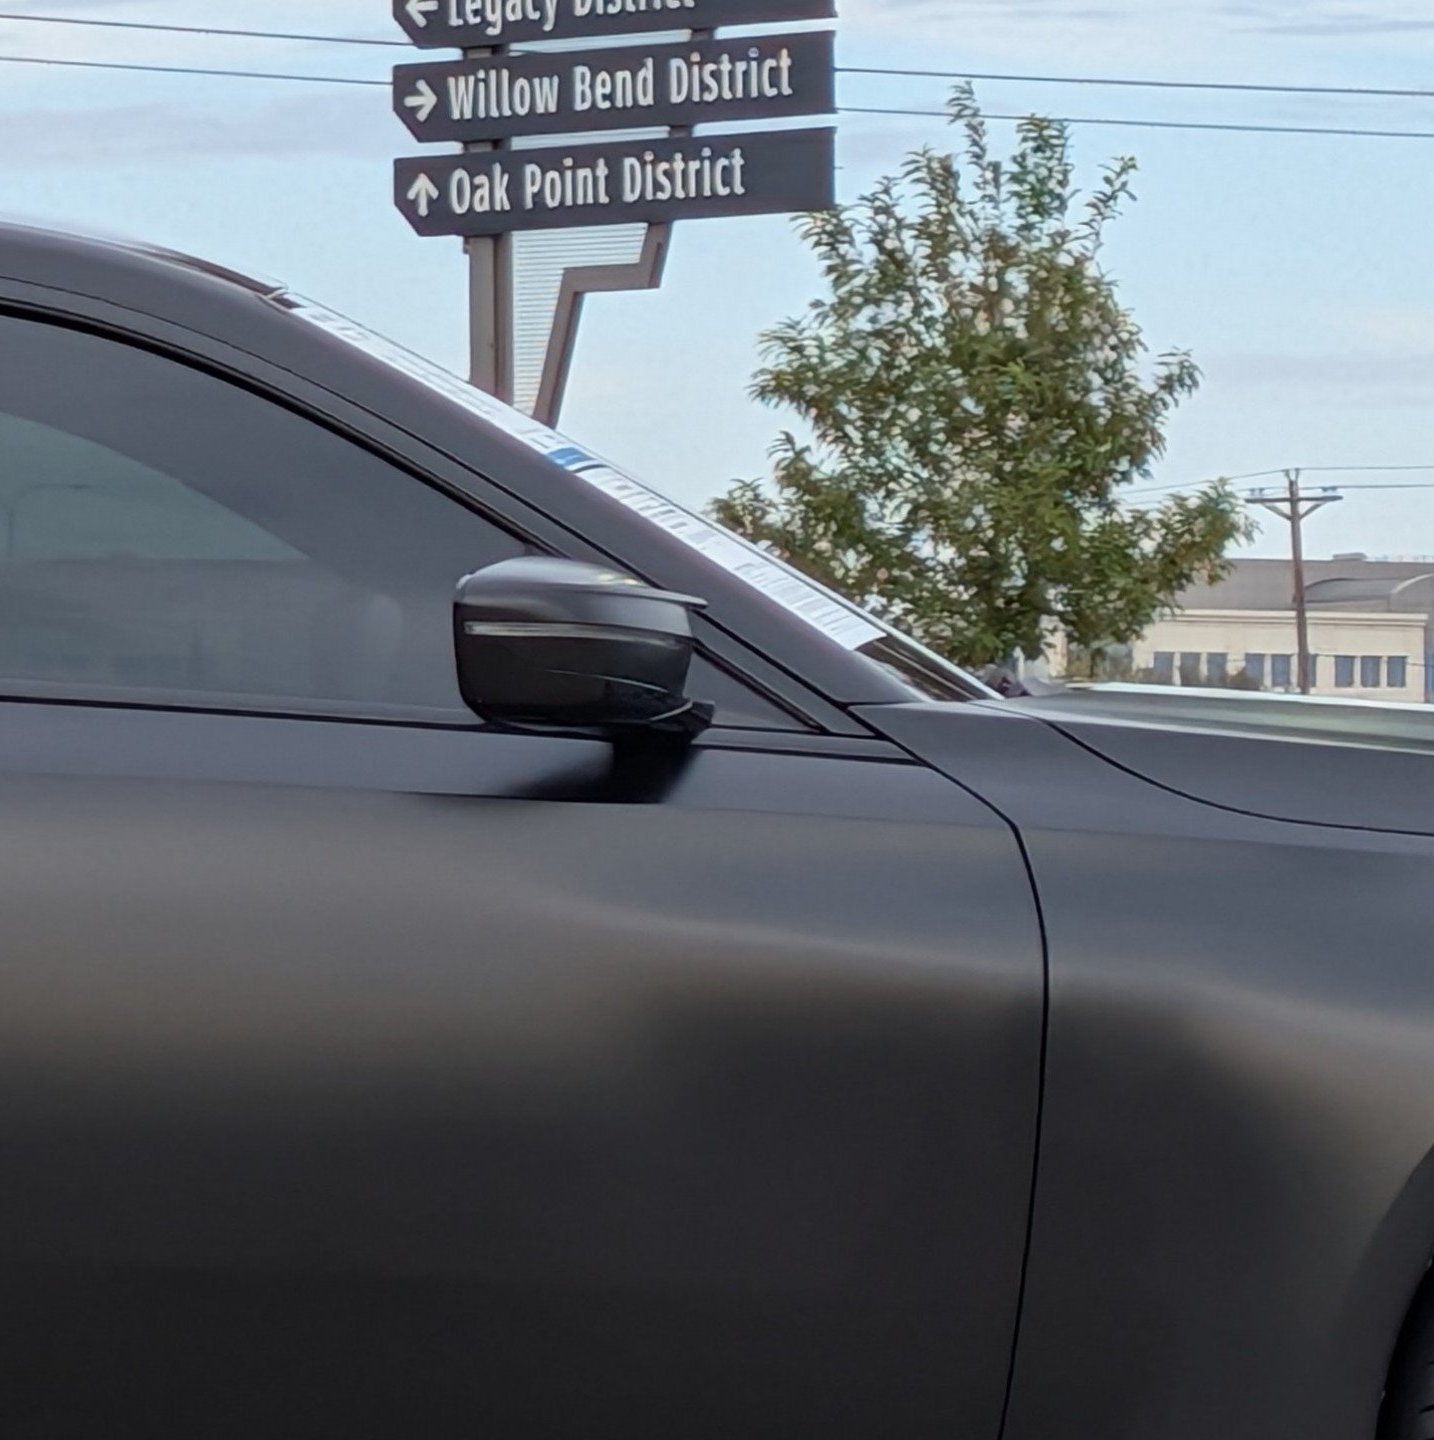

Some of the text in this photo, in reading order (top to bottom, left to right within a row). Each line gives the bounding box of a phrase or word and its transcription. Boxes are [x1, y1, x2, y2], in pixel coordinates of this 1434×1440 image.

[448, 48, 792, 120] Willow Bend District
[450, 148, 745, 214] Oak Point District
